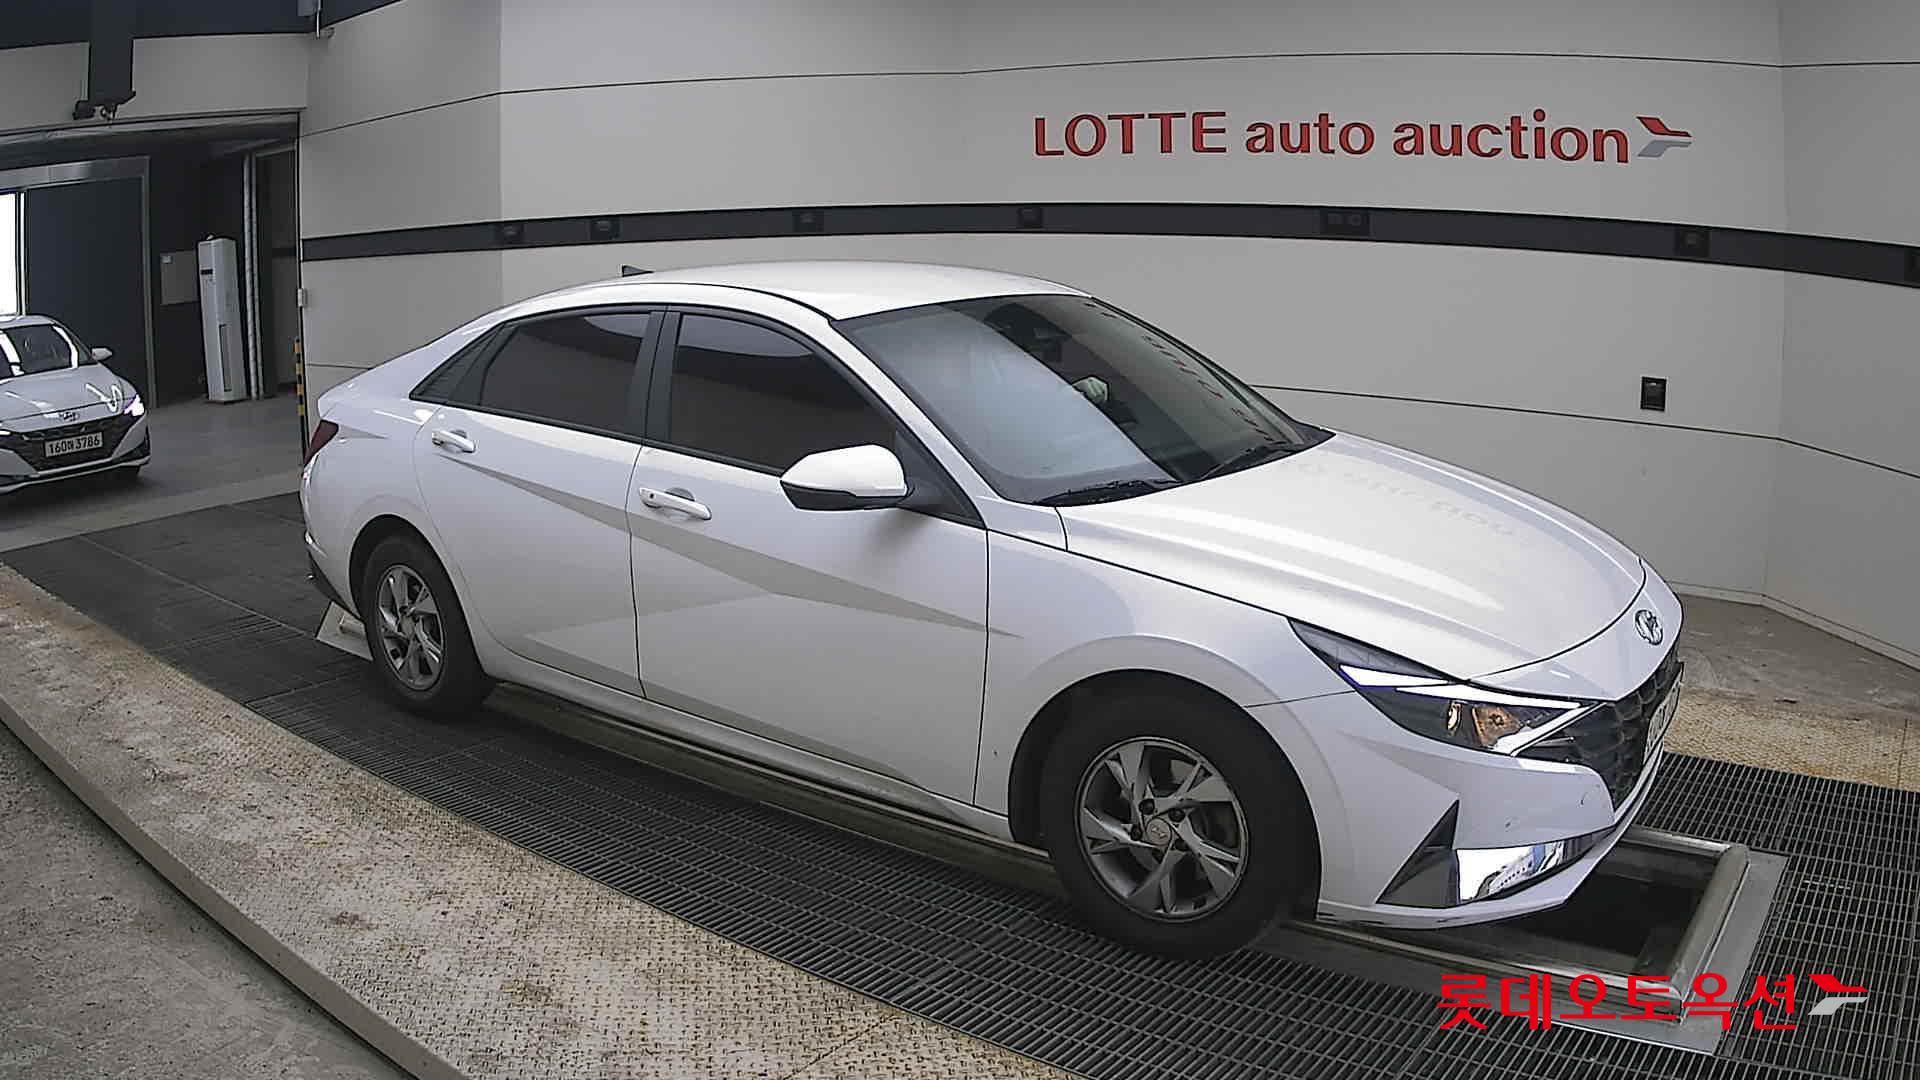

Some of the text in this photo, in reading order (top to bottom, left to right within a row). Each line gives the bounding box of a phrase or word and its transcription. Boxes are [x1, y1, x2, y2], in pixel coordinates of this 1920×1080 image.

[1034, 108, 1629, 163] LOTTE auto auction
